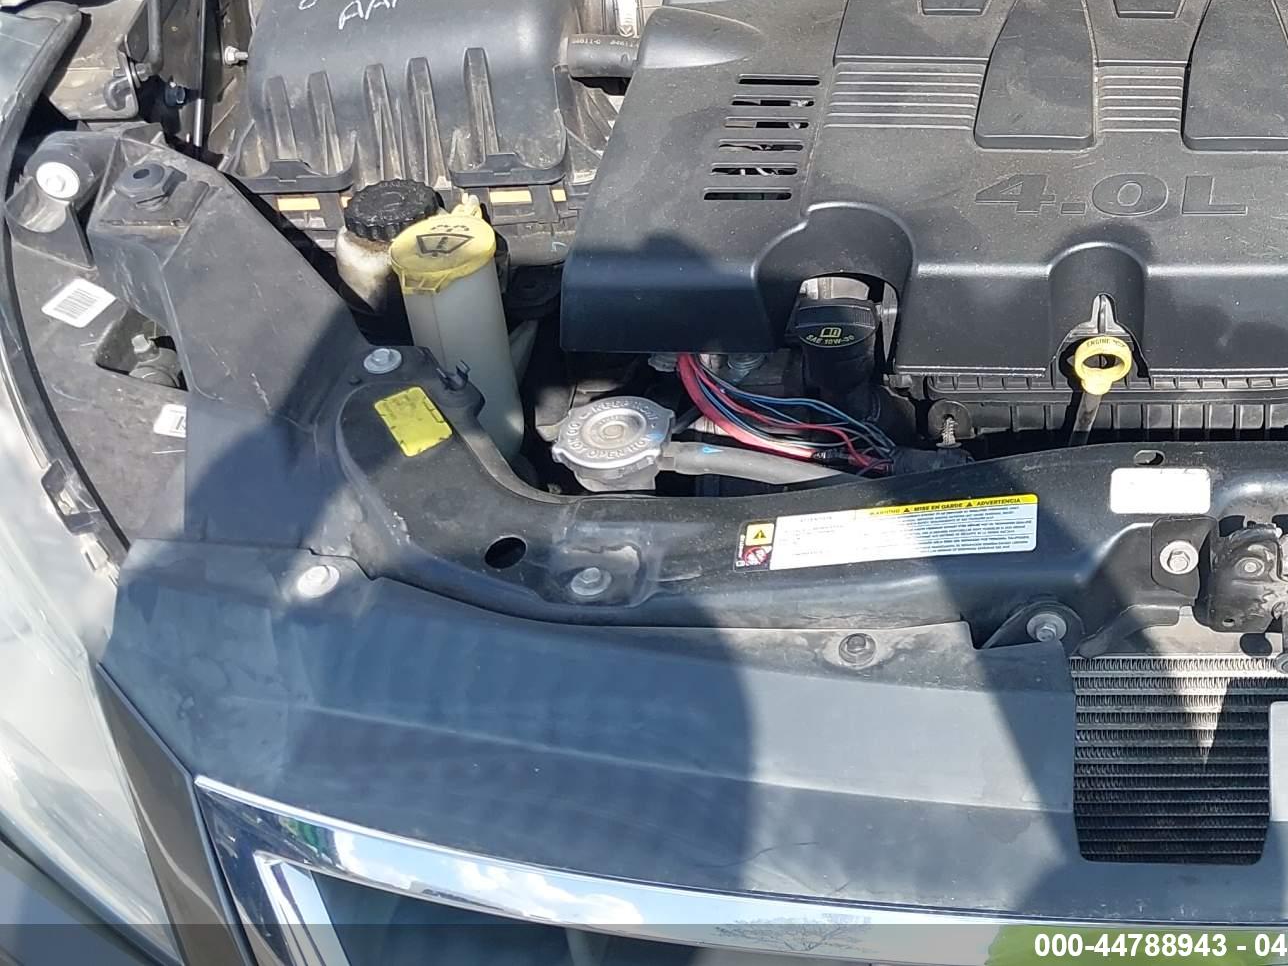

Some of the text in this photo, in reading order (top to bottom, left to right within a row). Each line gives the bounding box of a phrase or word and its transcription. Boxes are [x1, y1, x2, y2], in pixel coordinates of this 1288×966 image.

[975, 173, 1249, 215] 4.0L
[806, 334, 823, 344] SAE
[1086, 338, 1111, 348] ENGINE
[587, 449, 626, 460] OPEN
[941, 502, 963, 510] GARDE
[976, 497, 1021, 507] ADVERTENCIA
